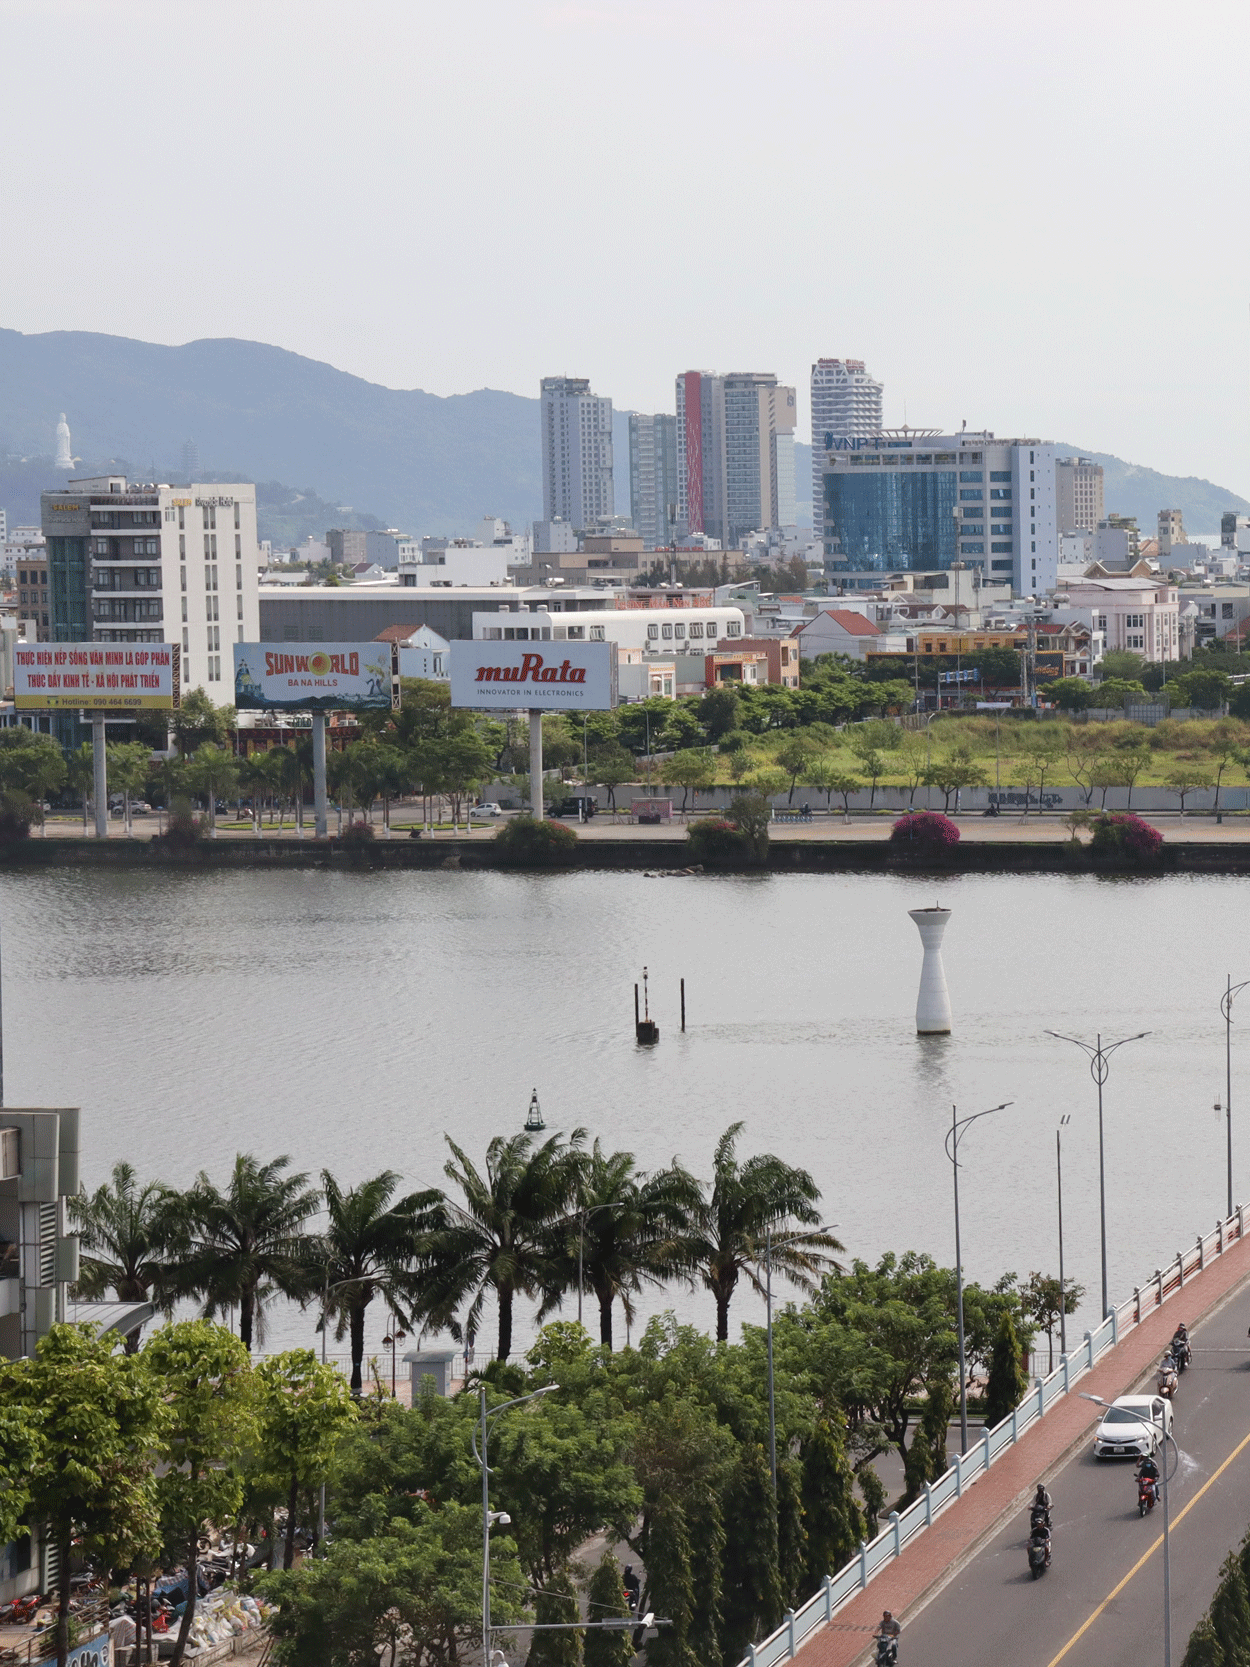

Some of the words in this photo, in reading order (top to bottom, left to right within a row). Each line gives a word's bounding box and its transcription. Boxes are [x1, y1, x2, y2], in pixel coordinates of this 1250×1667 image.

[833, 438, 883, 450] VNPT
[69, 647, 88, 666] SỐNG
[105, 651, 124, 666] MINH
[474, 653, 586, 683] muRata
[63, 674, 80, 688] KINH
[120, 671, 138, 688] PHÁT
[288, 679, 299, 687] BA
[301, 679, 312, 687] NA
[314, 679, 338, 687] HILLS
[534, 689, 584, 697] ELECTRONICS
